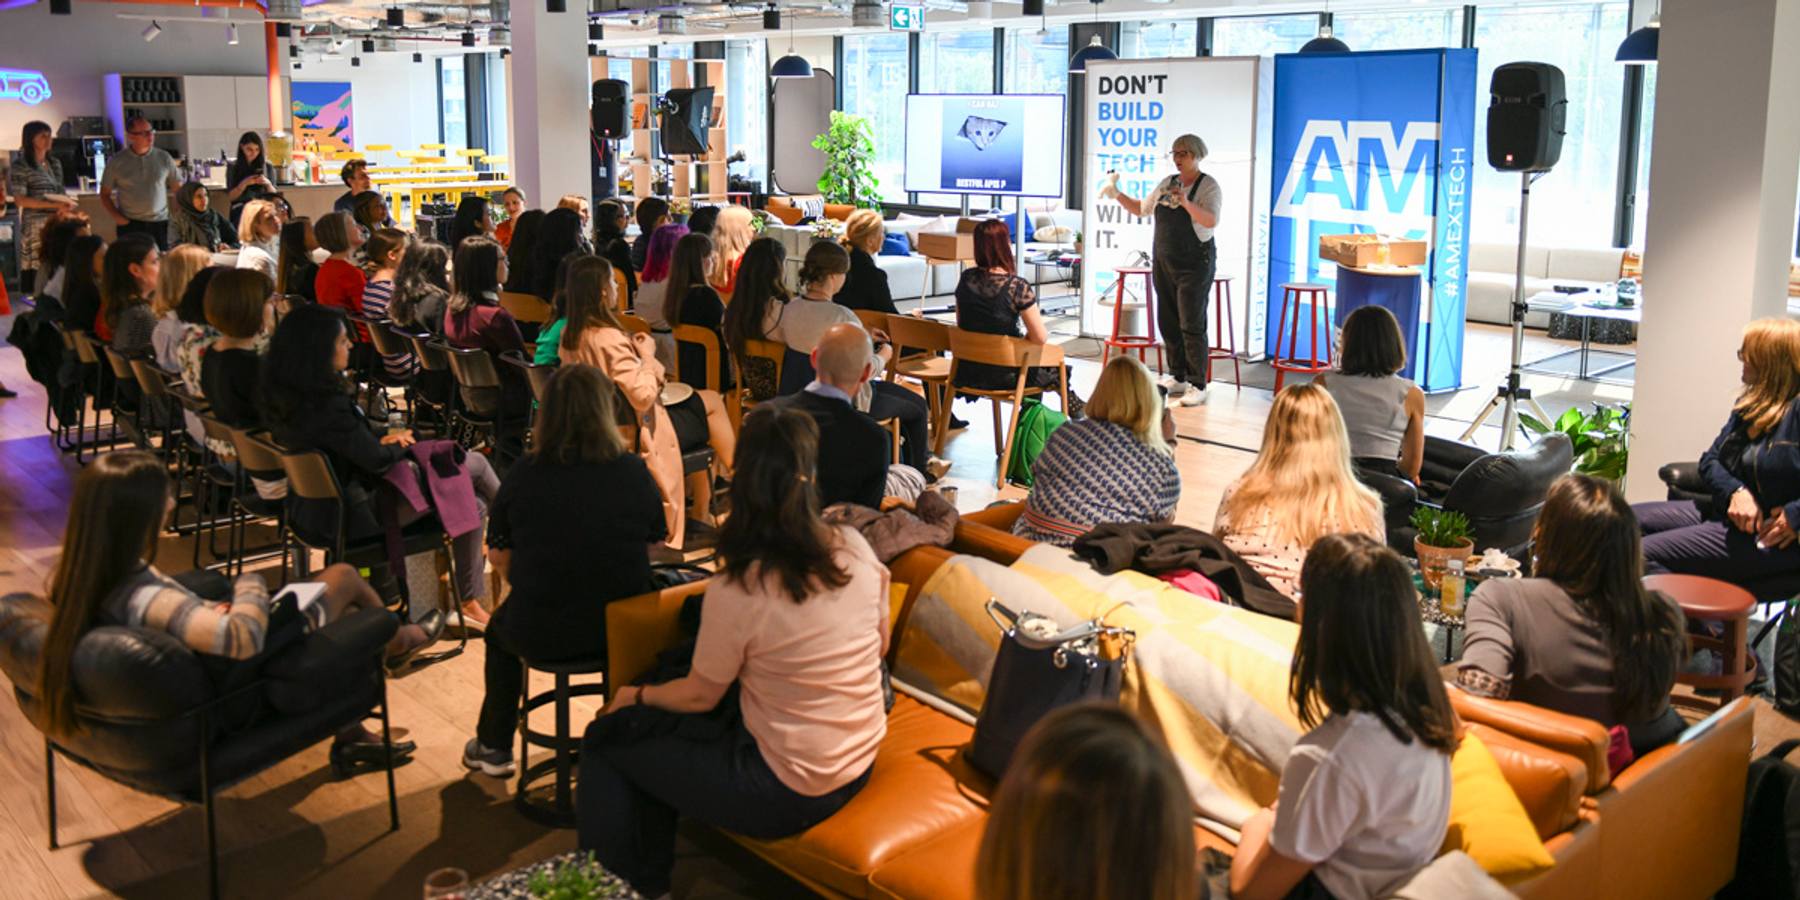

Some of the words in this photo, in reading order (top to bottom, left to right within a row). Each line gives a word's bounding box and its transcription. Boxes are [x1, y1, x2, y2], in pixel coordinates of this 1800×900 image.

[1098, 75, 1168, 95] DON'T
[1098, 101, 1164, 121] BUILD
[1097, 127, 1158, 147] YOUR
[1097, 153, 1155, 173] TECH
[1443, 147, 1466, 298] #AMEXTECH
[1095, 230, 1118, 248] IT.
